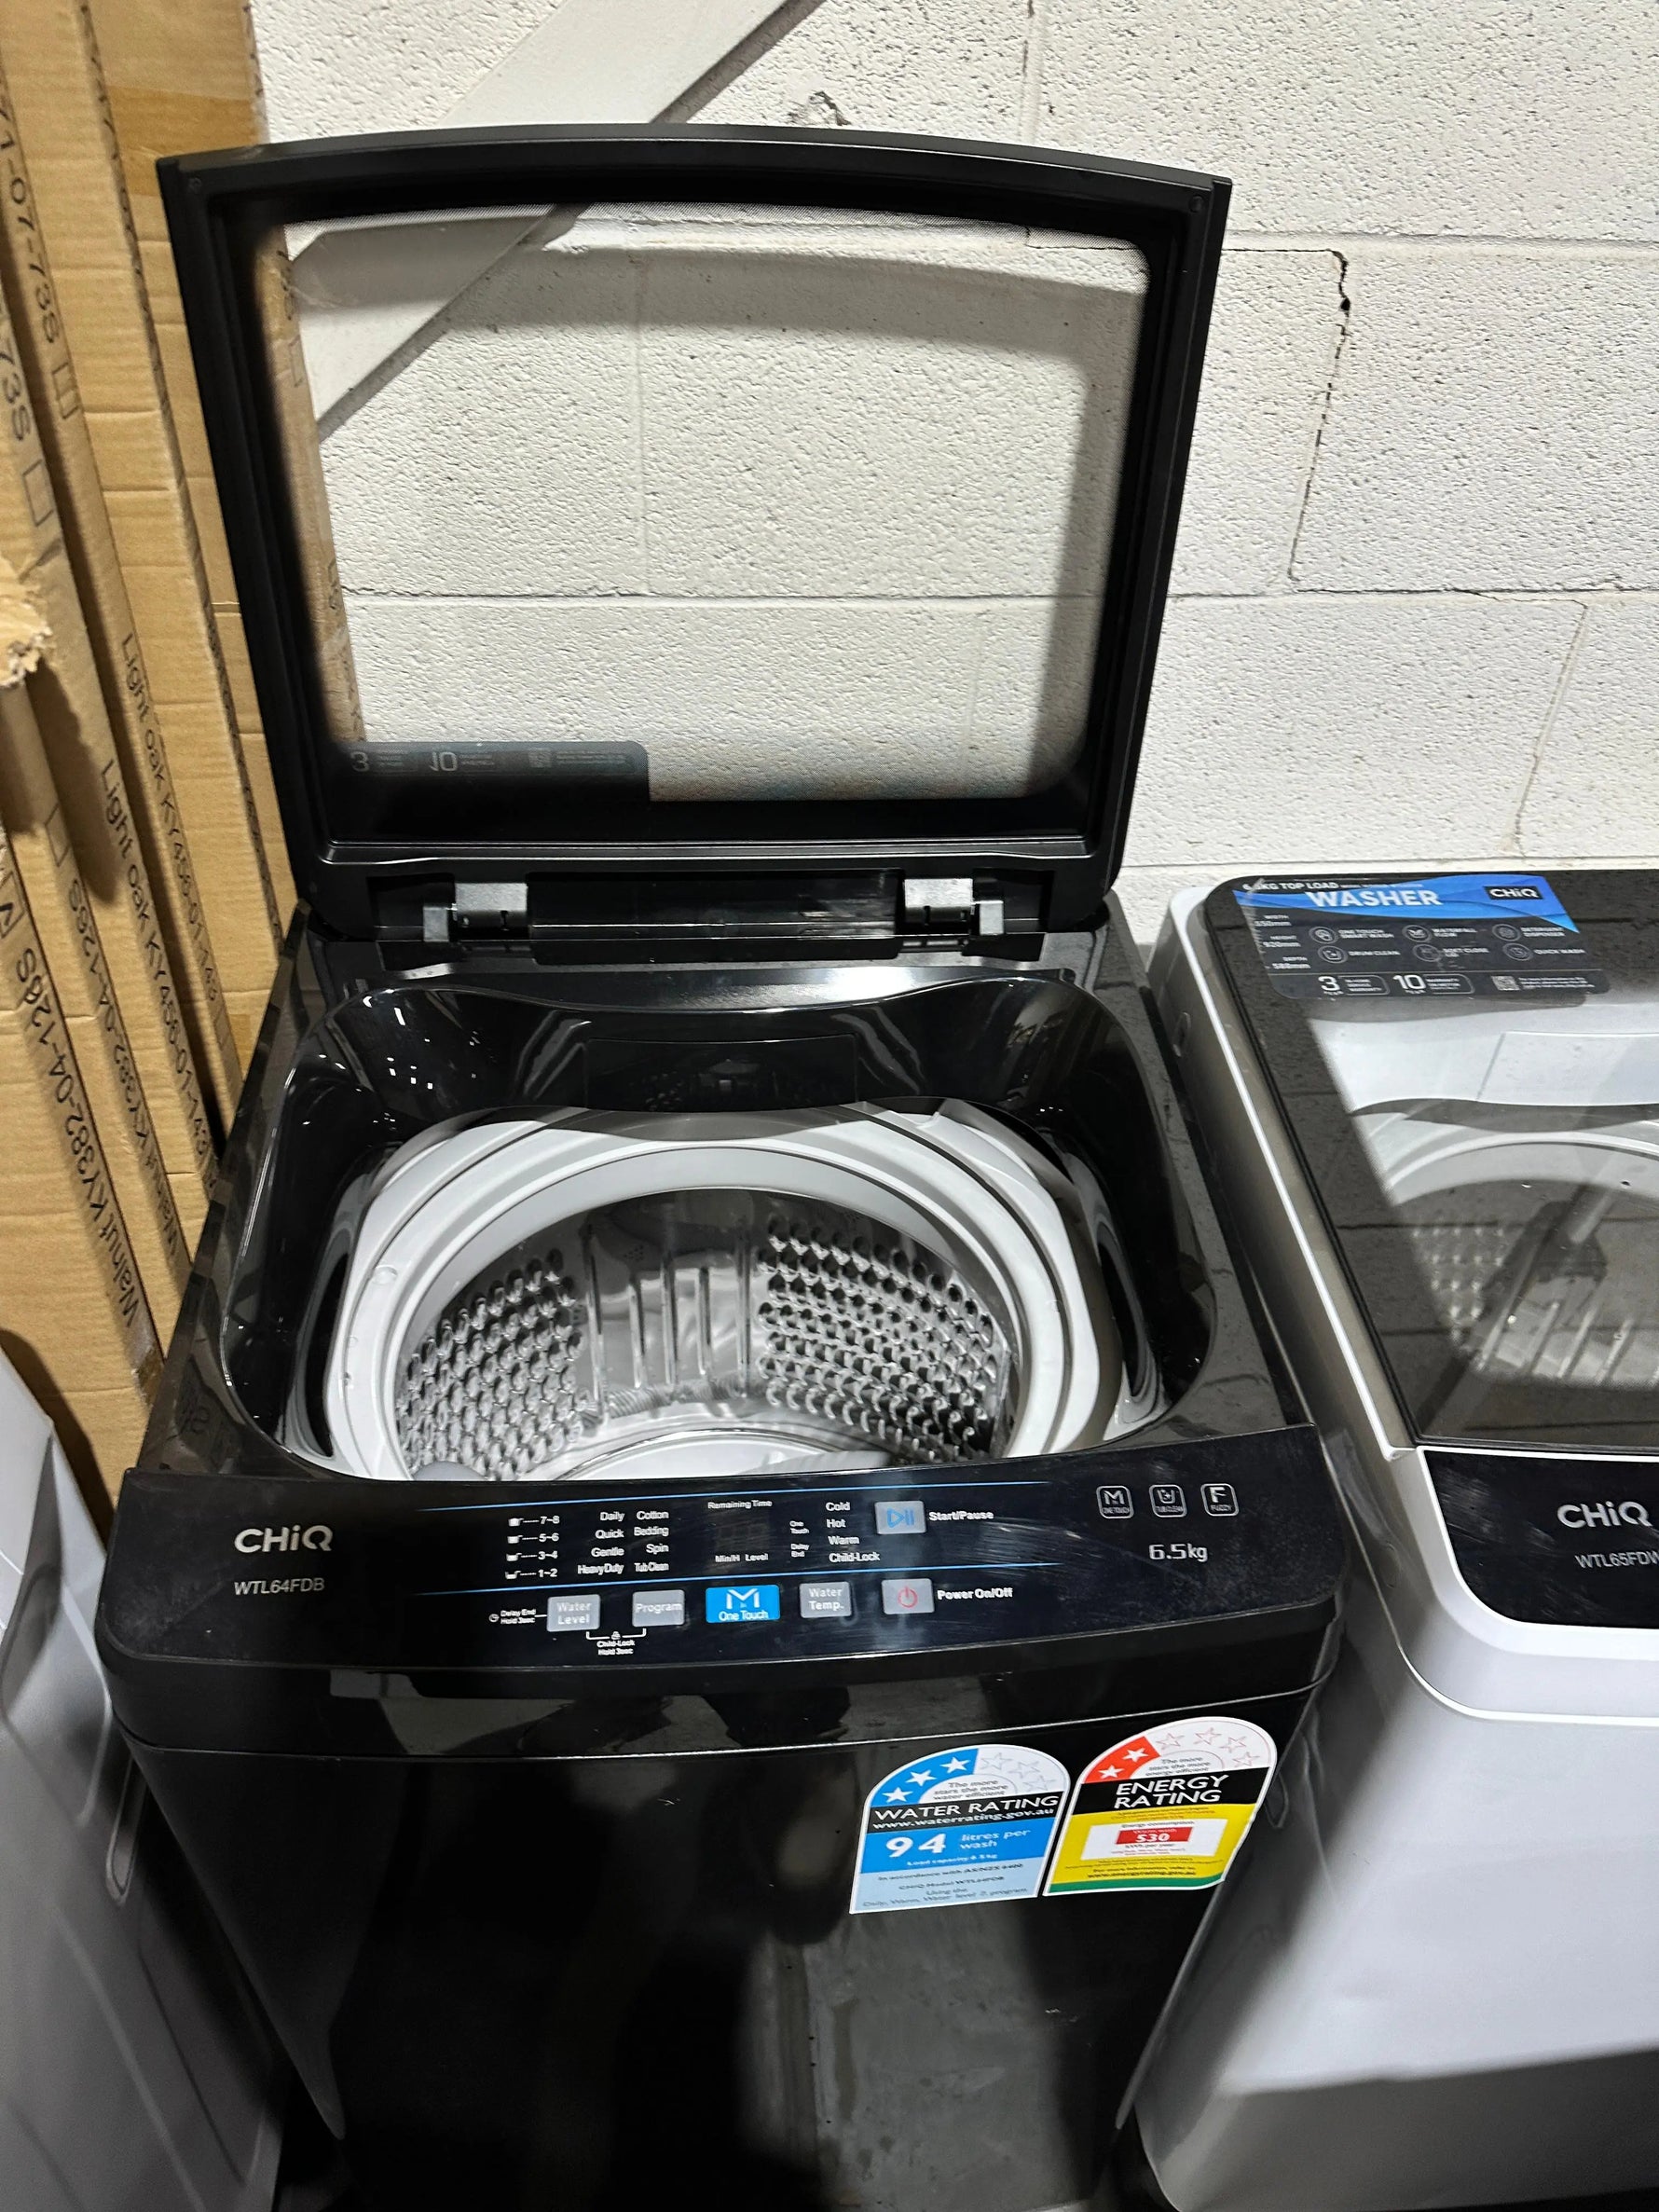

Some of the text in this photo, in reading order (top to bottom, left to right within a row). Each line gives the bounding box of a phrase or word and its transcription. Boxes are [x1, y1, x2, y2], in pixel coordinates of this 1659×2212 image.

[0, 104, 61, 344] 1-07-73S
[122, 634, 149, 723] Light
[144, 729, 166, 791] oak
[101, 758, 133, 859] Light
[128, 863, 151, 933] oak
[1280, 882, 1306, 890] TOP
[1489, 886, 1541, 899] CHiQ
[1305, 890, 1444, 907] WASHER
[1318, 975, 1341, 992] 3
[1392, 974, 1427, 990] 10
[16, 948, 138, 1328] Walnut KY382-04-126S
[1209, 1486, 1227, 1504] F
[707, 1499, 773, 1509] Remaining Time
[825, 1502, 851, 1512] Cold
[599, 1511, 625, 1522] Daily
[636, 1510, 669, 1521] Cotton
[928, 1510, 994, 1522] Start/Pause
[1556, 1500, 1653, 1529] CHiQ
[826, 1518, 846, 1529] Hot
[595, 1529, 625, 1540] Quick
[633, 1526, 669, 1537] Bedding
[234, 1524, 334, 1553] CHiQ
[828, 1535, 860, 1546] Warm
[590, 1546, 625, 1558] Gentle
[645, 1544, 669, 1555] Spin
[1148, 1543, 1209, 1563] 6.5kg
[745, 1553, 769, 1562] Level
[829, 1551, 881, 1563] Child-Lock
[234, 1577, 325, 1596] WTL64FDB
[808, 1587, 843, 1598] Water
[937, 1587, 1013, 1601] Power On/Off
[556, 1601, 592, 1613] Water
[635, 1601, 683, 1614] Program
[808, 1600, 844, 1612] Temp.
[557, 1614, 591, 1625] Level
[718, 1609, 769, 1622] One Touch
[1116, 1774, 1229, 1796] ENERGY
[1114, 1790, 1223, 1809] RATING
[874, 1795, 1060, 1820] WATER RATING
[871, 1807, 1055, 1830] www.waterrating.gov.au
[961, 1829, 1031, 1842] litres per
[1134, 1833, 1171, 1843] 530
[885, 1833, 947, 1858] 94
[959, 1840, 998, 1849] wash
